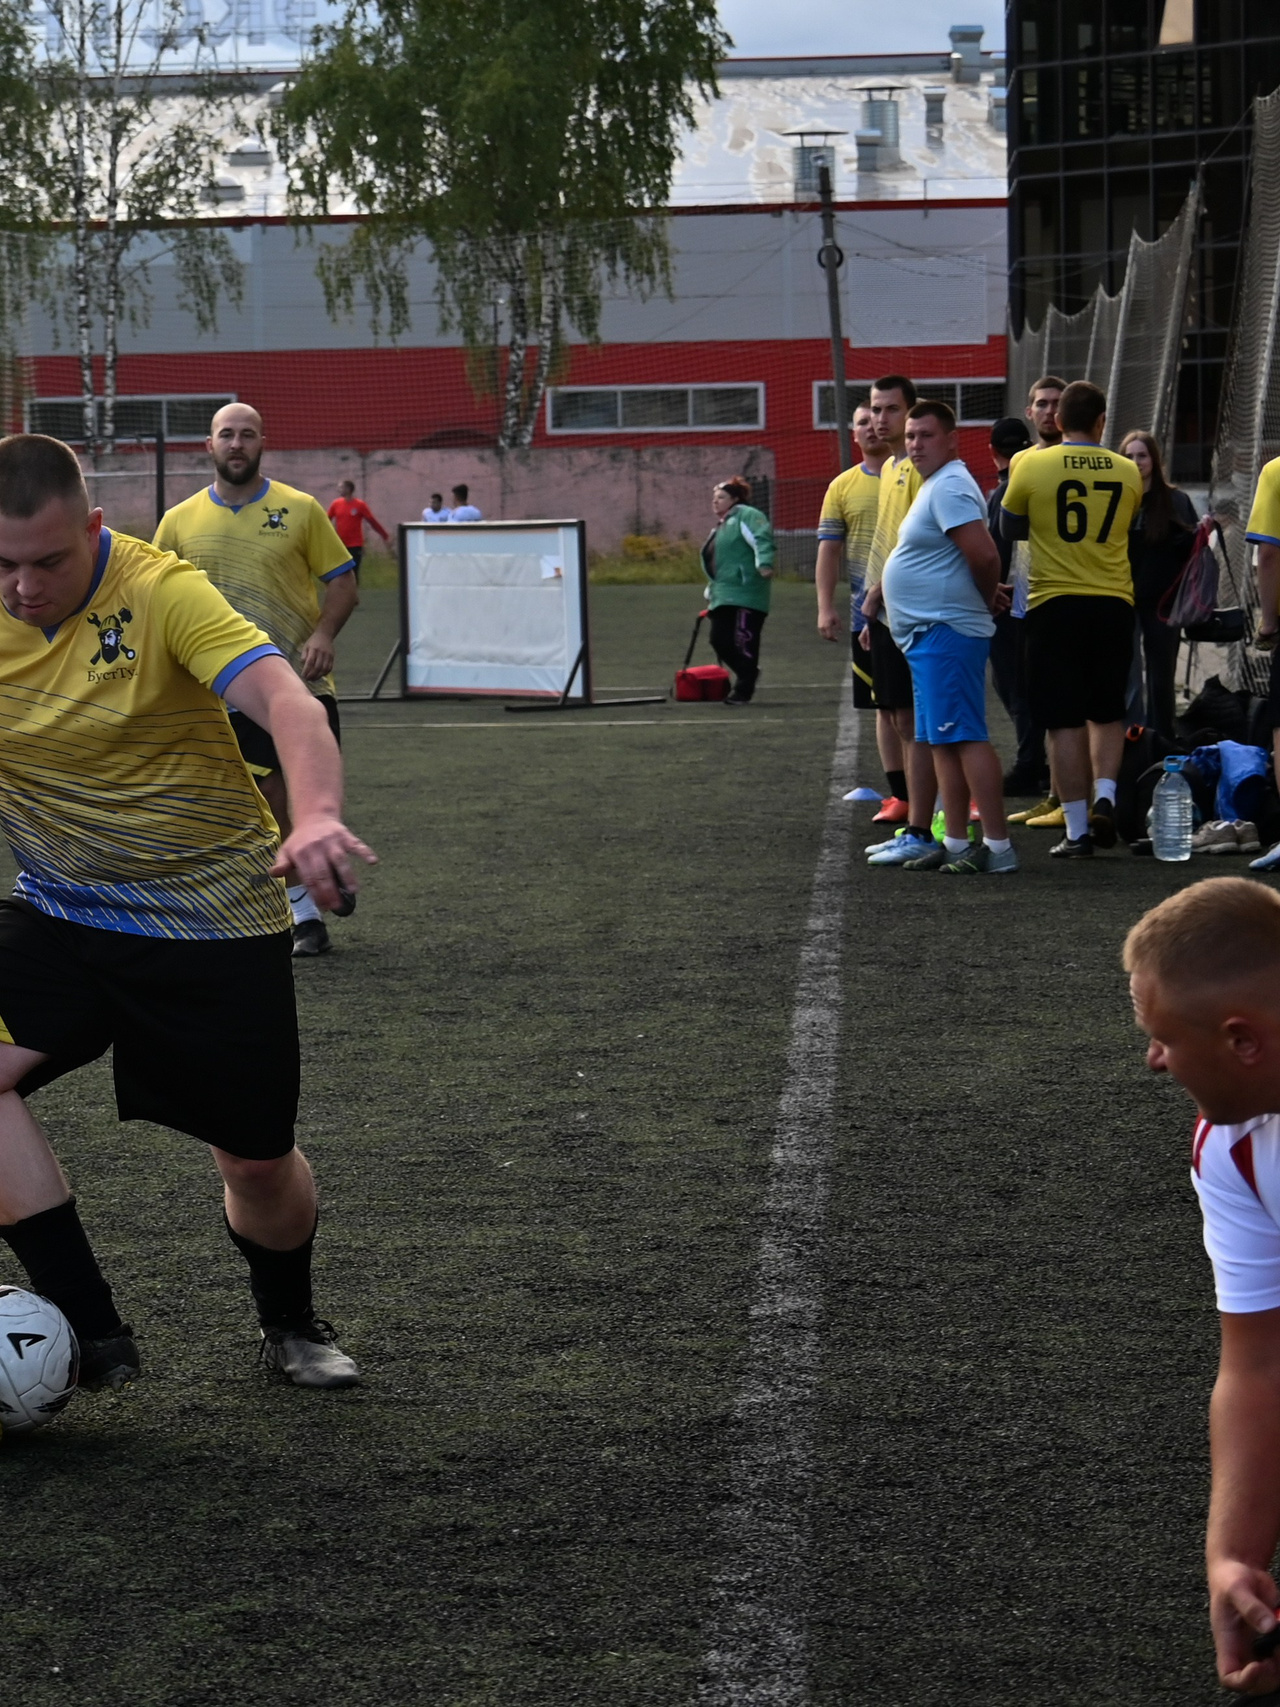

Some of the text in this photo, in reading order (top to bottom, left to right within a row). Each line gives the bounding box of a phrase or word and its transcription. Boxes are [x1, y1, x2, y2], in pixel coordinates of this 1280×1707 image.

[1063, 455, 1113, 471] ГЕРЦЕВ
[1056, 479, 1123, 543] 67
[87, 667, 138, 684] БустТу
